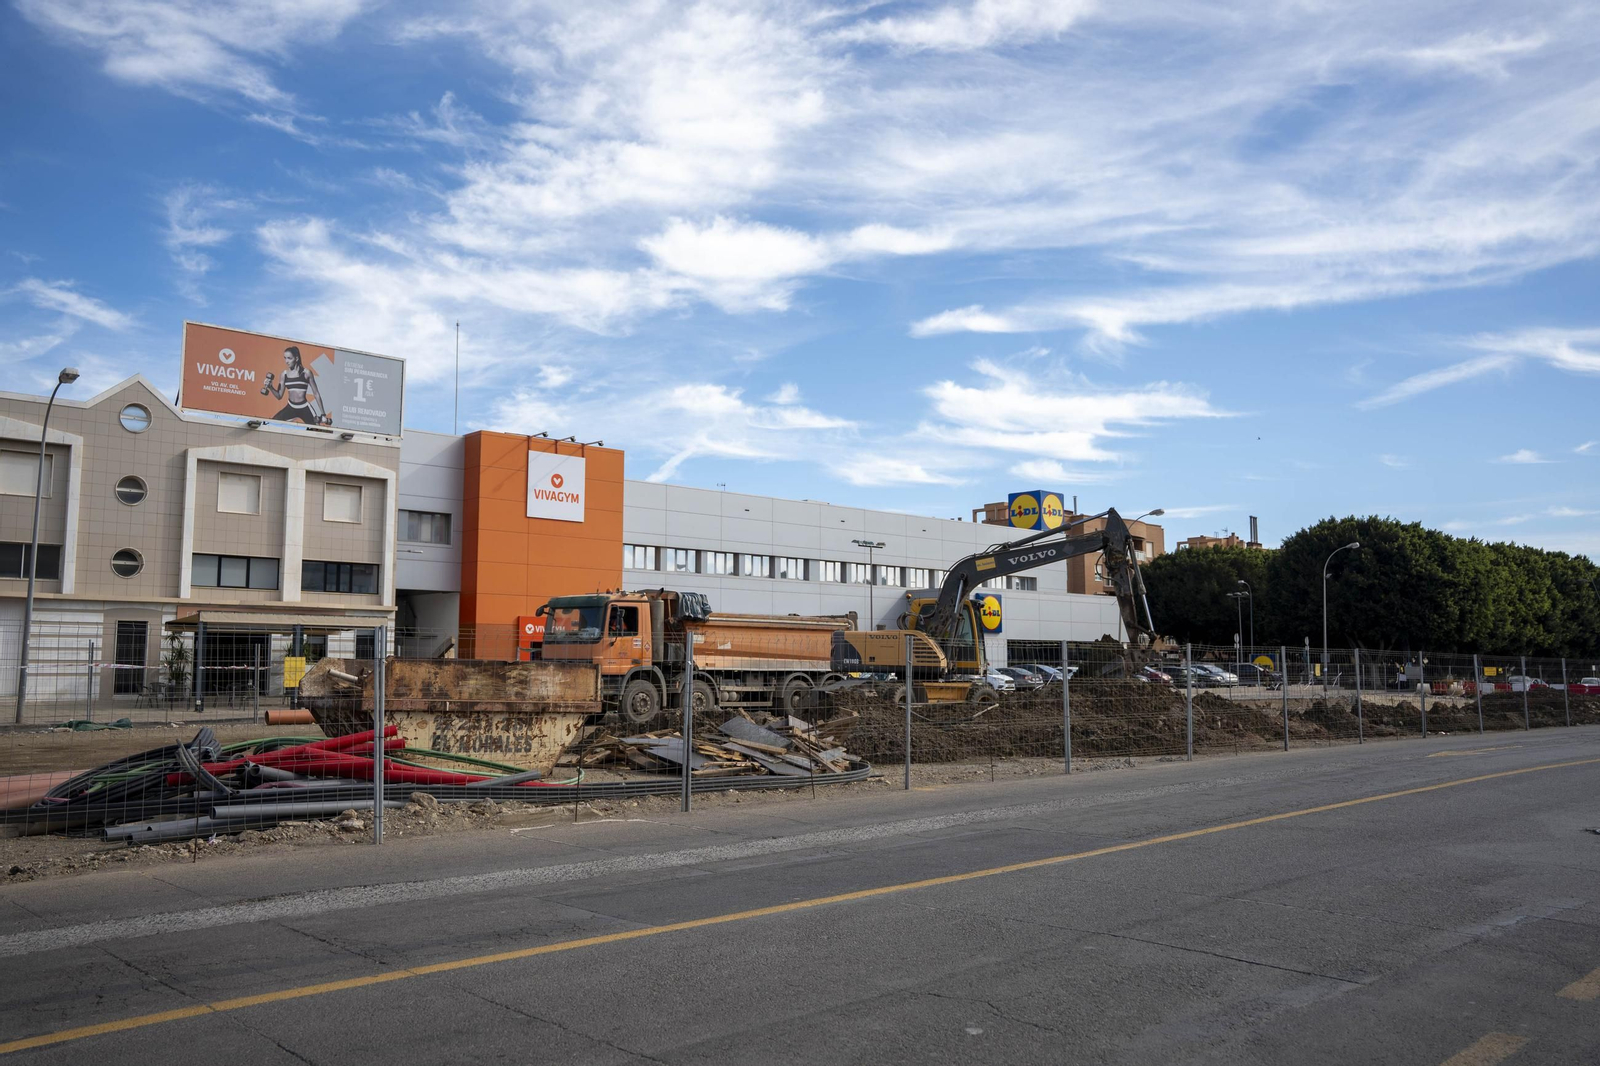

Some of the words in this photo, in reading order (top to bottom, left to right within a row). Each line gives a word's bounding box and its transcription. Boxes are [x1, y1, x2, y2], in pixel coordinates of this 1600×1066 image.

[196, 362, 255, 382] VIVAGYM
[342, 405, 357, 414] CLUB
[357, 407, 387, 418] RENOVADO
[534, 488, 579, 504] VIVAGYM
[1008, 549, 1056, 565] VOLVO
